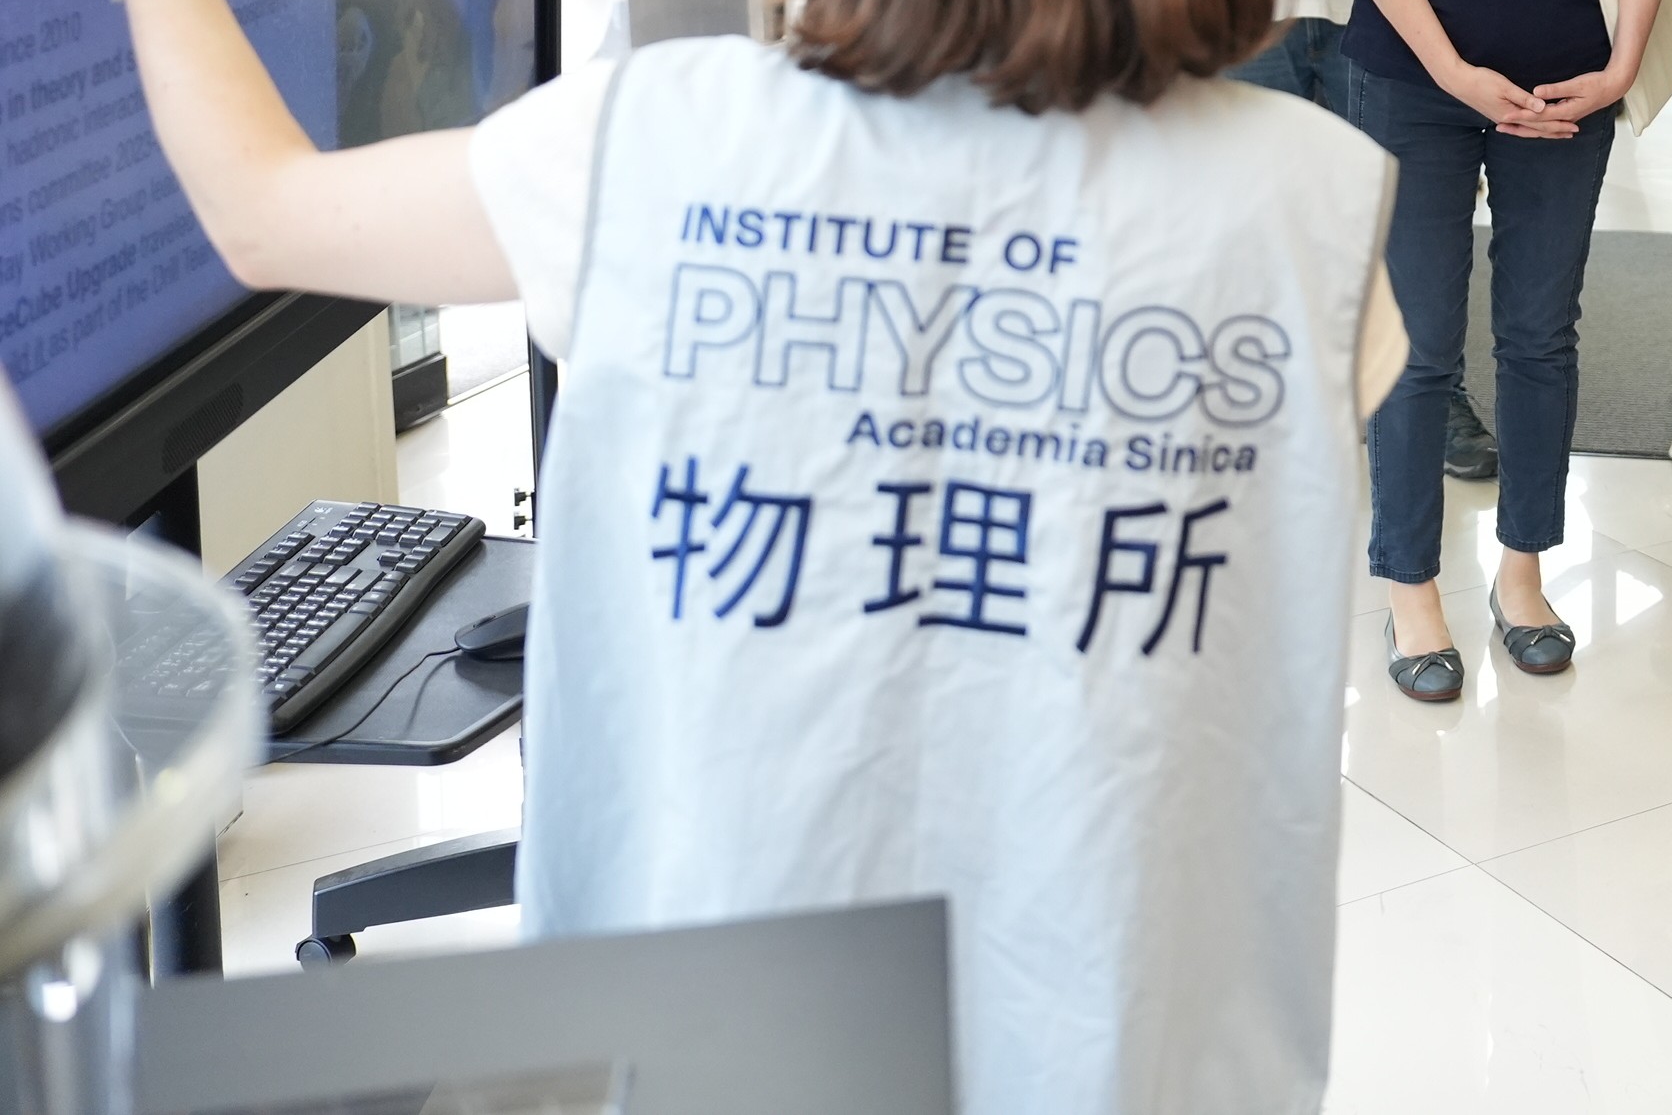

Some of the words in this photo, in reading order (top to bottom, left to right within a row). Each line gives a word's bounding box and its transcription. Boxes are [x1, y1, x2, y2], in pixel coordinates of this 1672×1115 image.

[40, 10, 82, 53] 2010
[8, 88, 26, 122] in
[31, 67, 87, 111] theory
[91, 47, 123, 87] and
[28, 154, 112, 214] committee
[28, 212, 97, 267] Working
[100, 188, 148, 230] Group
[681, 203, 972, 266] INSTITUTE
[1003, 230, 1080, 275] OF
[66, 241, 137, 304] Upgrade
[73, 302, 104, 353] part
[662, 261, 1293, 427] PHYSICS
[847, 410, 1107, 469] Academia
[1125, 433, 1257, 475] Sinica
[651, 455, 1232, 656] 物理所
